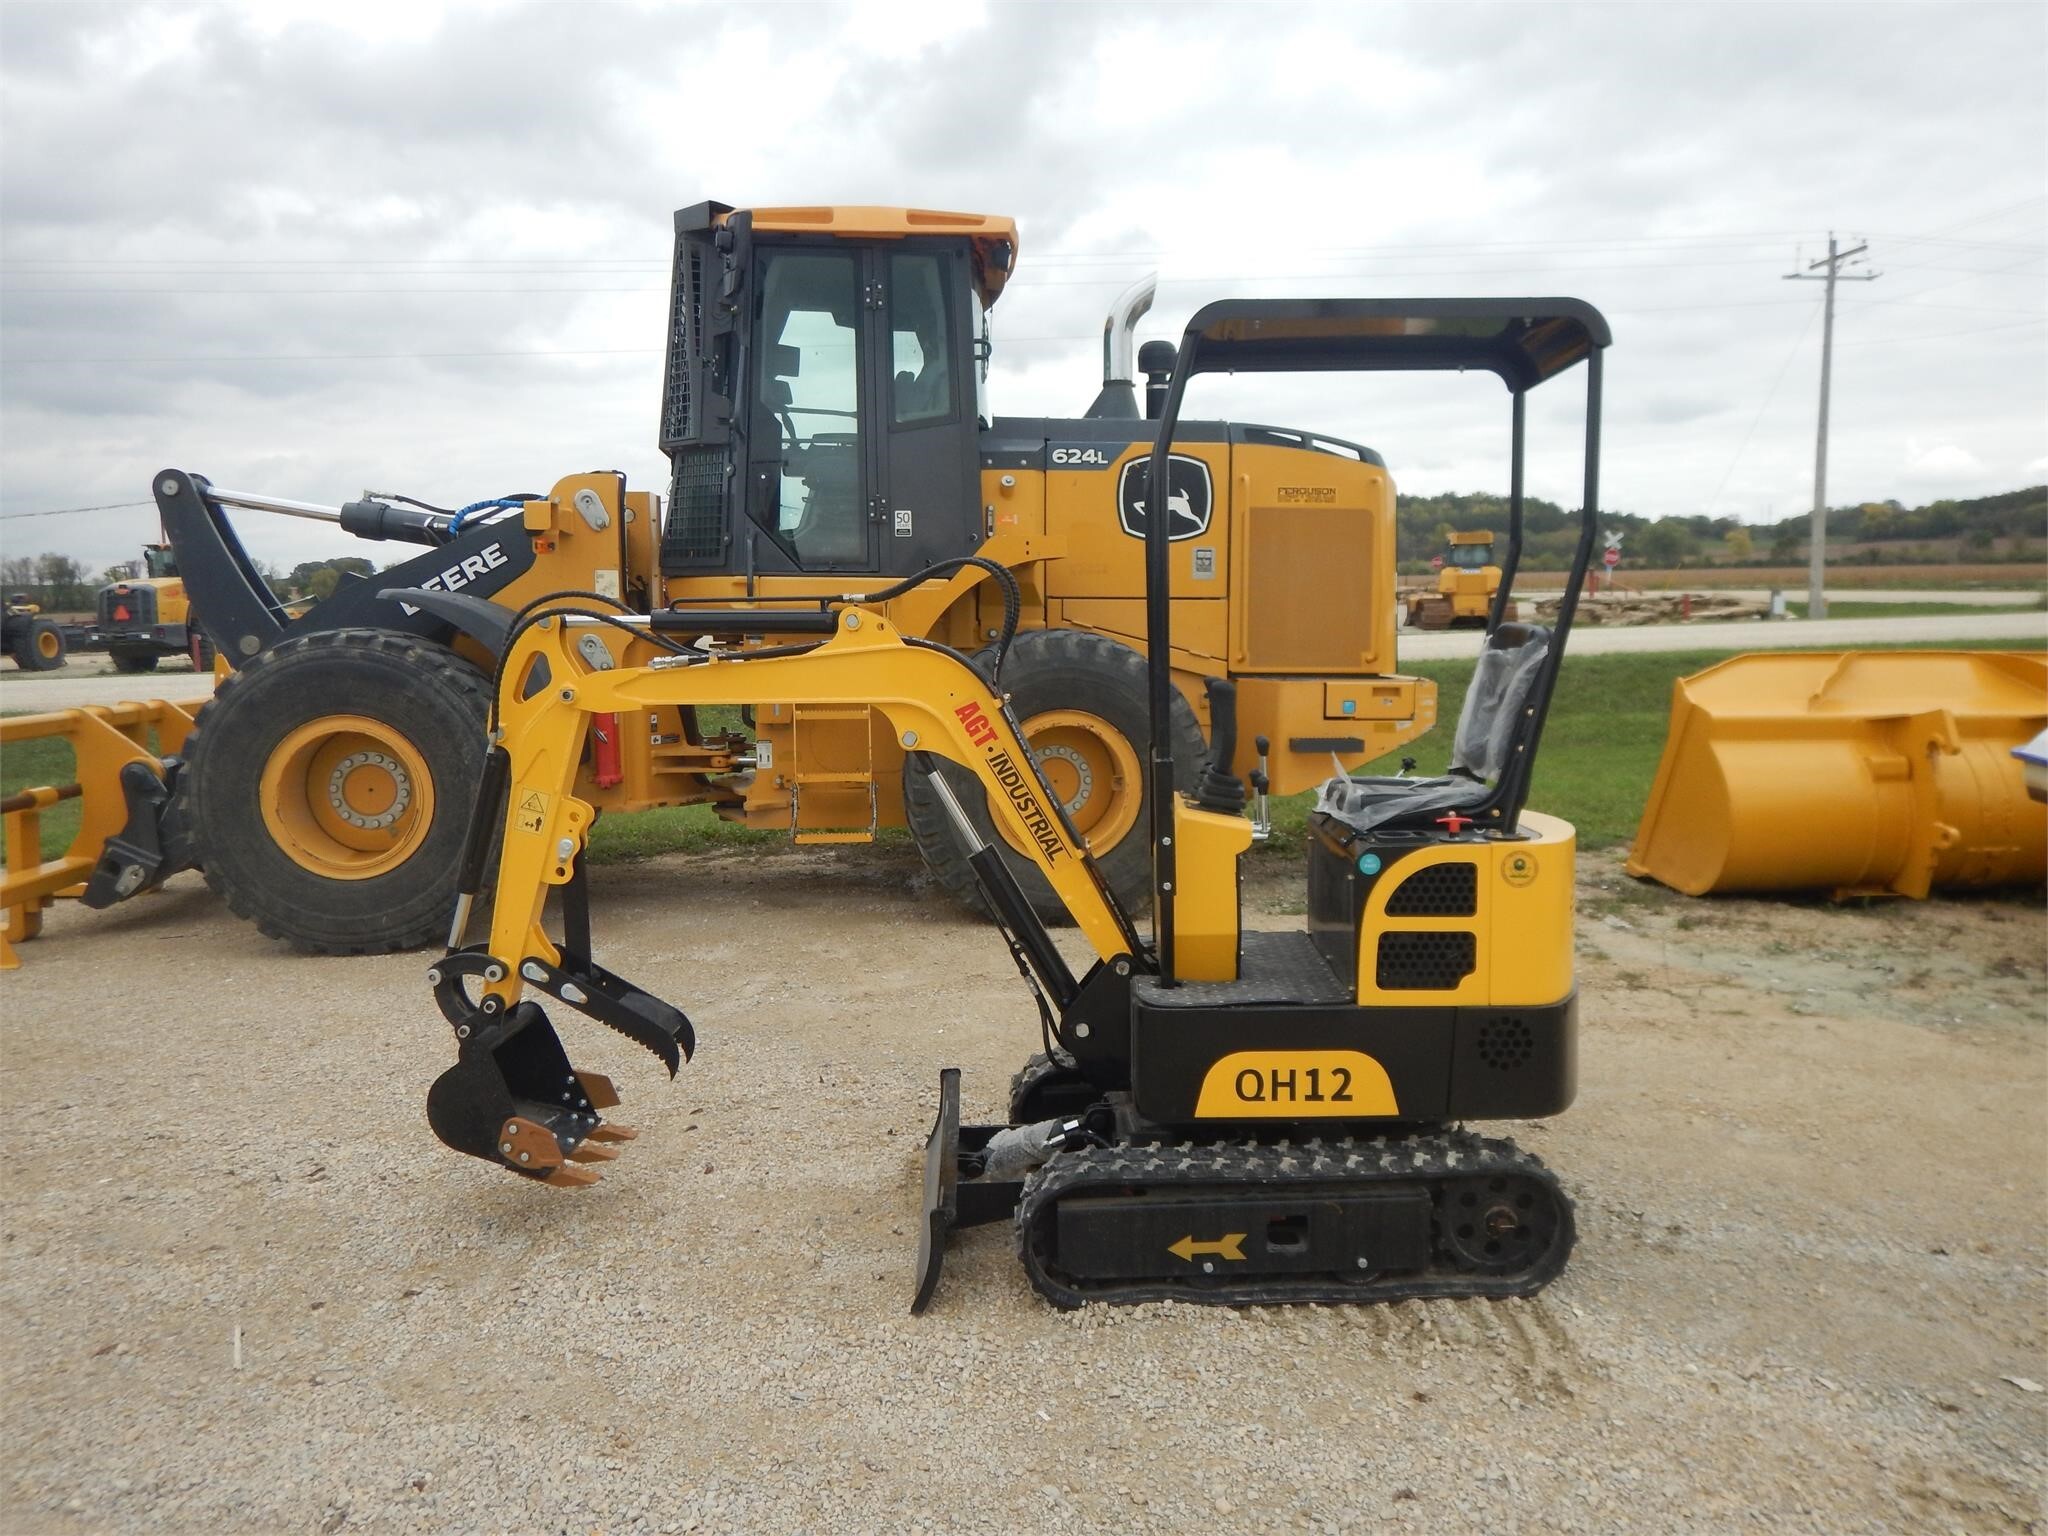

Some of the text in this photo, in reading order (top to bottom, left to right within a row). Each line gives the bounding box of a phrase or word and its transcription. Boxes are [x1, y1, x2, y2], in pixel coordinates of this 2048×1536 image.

[1052, 448, 1108, 464] 624L
[896, 512, 911, 523] 50
[954, 701, 1064, 862] AGT INDUSTRIAL
[1235, 1068, 1353, 1102] QH12
